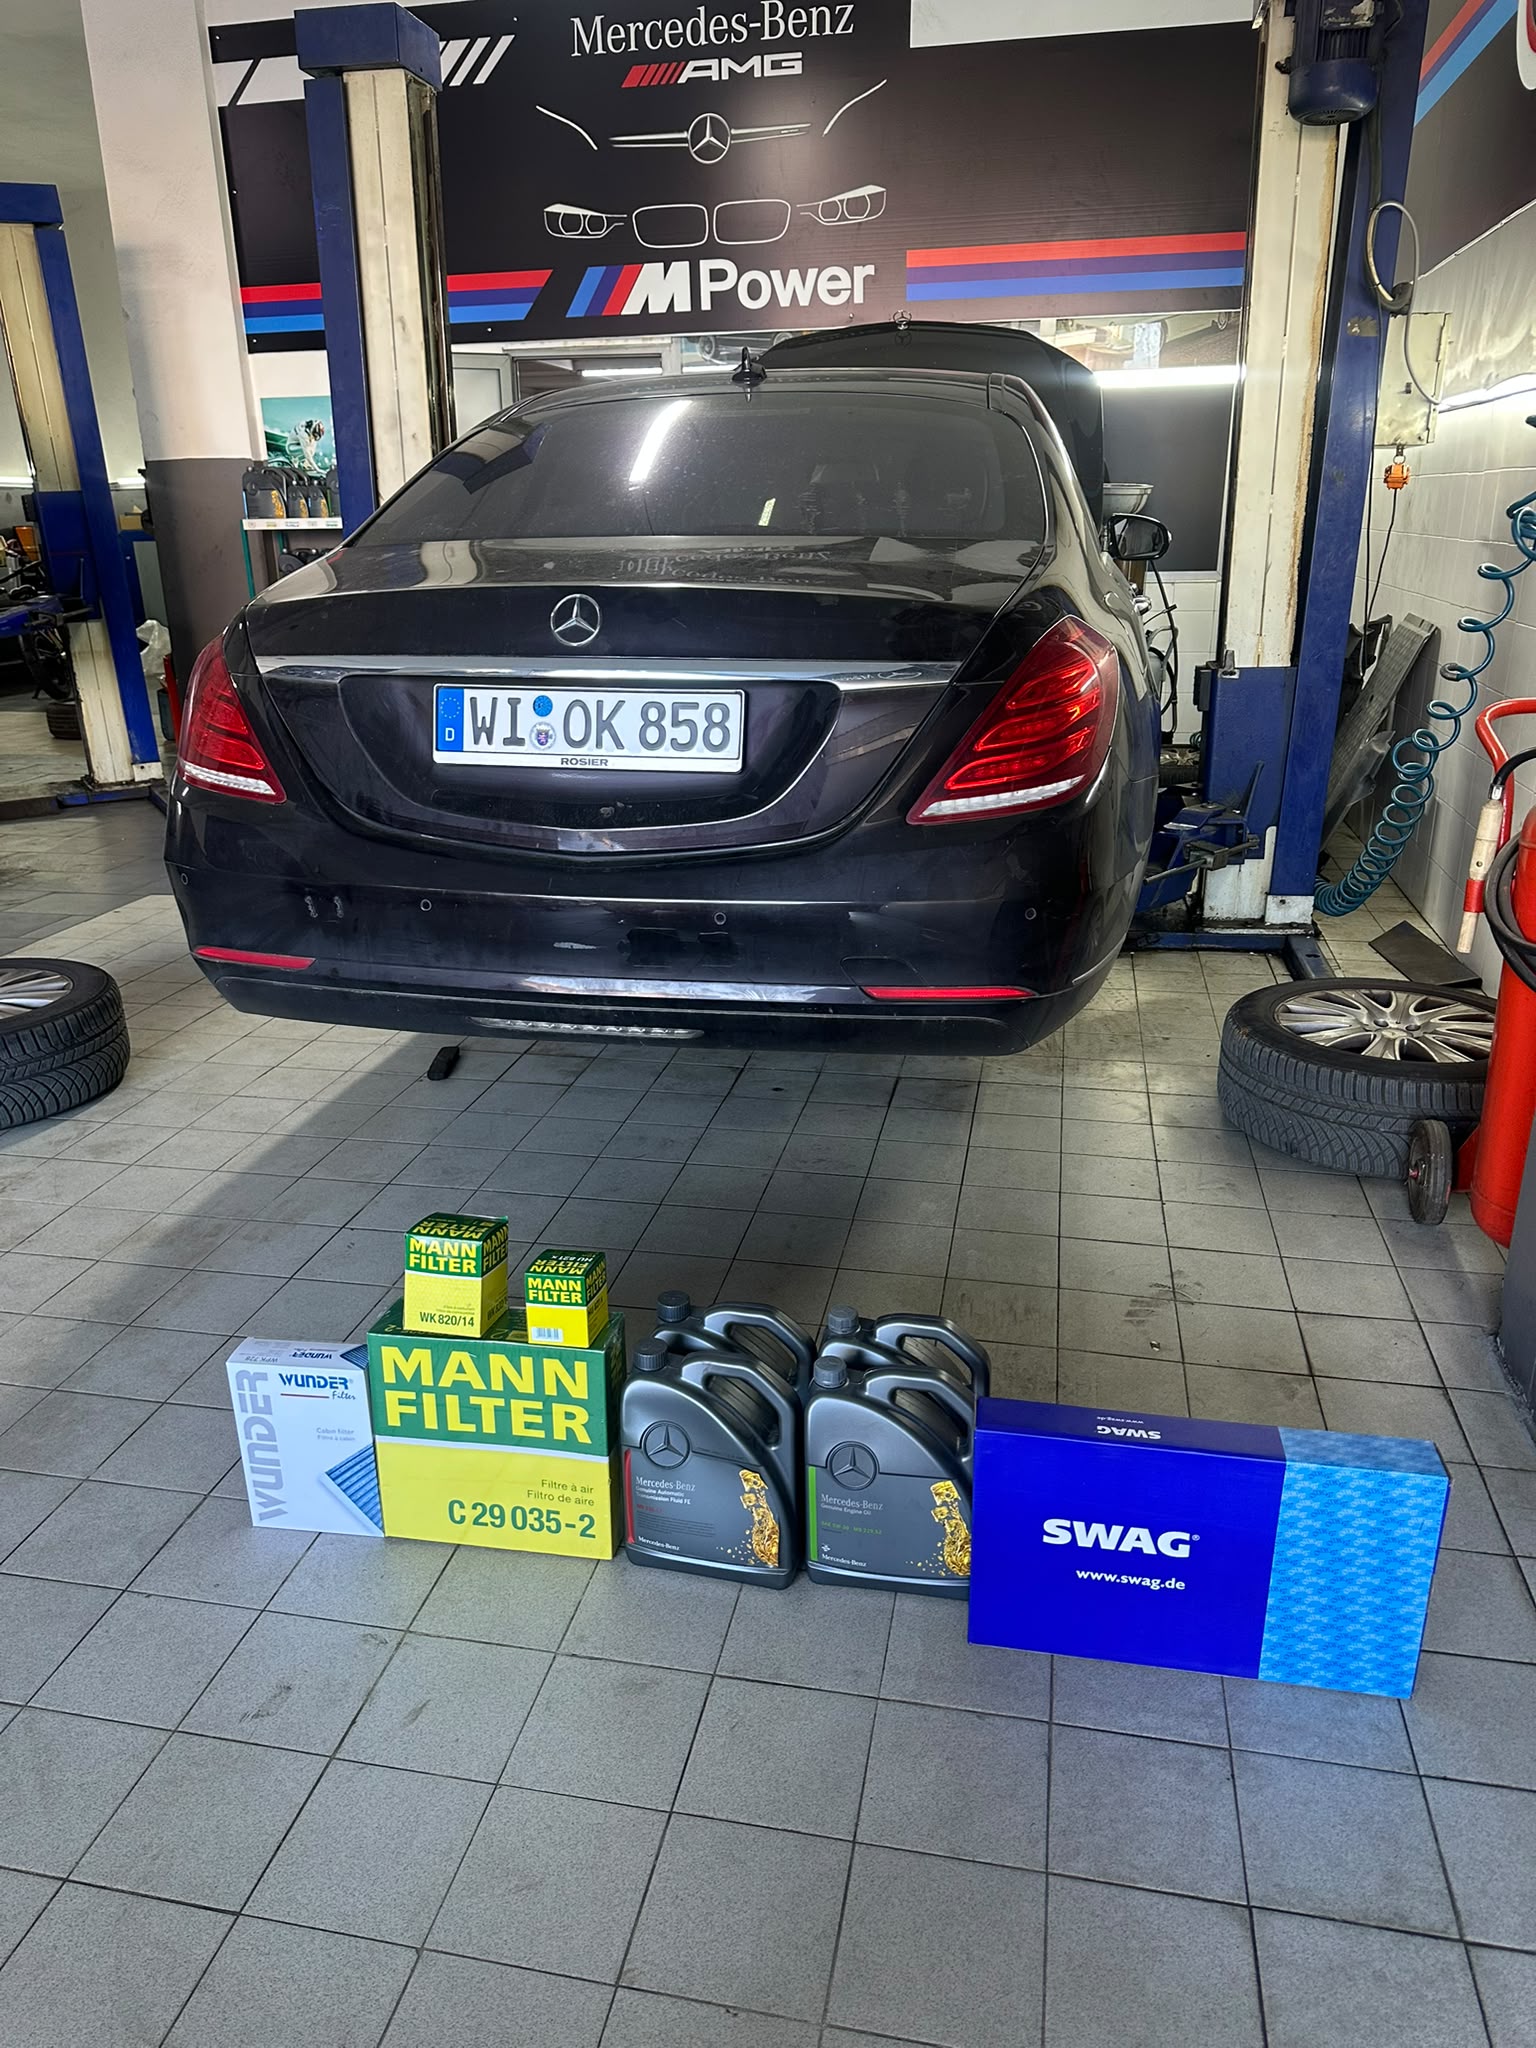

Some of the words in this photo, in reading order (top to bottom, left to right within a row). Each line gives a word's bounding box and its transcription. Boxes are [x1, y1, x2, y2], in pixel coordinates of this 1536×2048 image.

[571, 1, 855, 57] Mercedes-Benz
[678, 51, 803, 84] AMG
[701, 258, 876, 312] Power
[469, 696, 527, 748] WI
[563, 699, 627, 750] OK
[638, 701, 731, 753] 858
[445, 727, 455, 742] D
[560, 757, 609, 767] ROSIER
[412, 1226, 483, 1239] MANN
[409, 1237, 477, 1258] MANN
[409, 1252, 477, 1274] FILTER
[529, 1264, 585, 1275] MANN
[534, 1259, 589, 1268] FILTER
[527, 1277, 583, 1292] MANN
[528, 1289, 583, 1304] FILTER
[419, 1311, 436, 1324] WK
[438, 1312, 475, 1328] 820/14
[380, 1345, 589, 1400] MANN
[279, 1373, 349, 1390] WUNDER
[332, 1391, 356, 1401] Filter
[384, 1389, 593, 1445] FILTER
[1096, 1425, 1161, 1440] SWAG
[235, 1369, 289, 1521] WUNDER
[541, 1479, 568, 1491] Filtre
[580, 1485, 594, 1494] air
[636, 1476, 696, 1491] Mercedes-Benz
[527, 1489, 555, 1501] Filtro
[558, 1493, 571, 1504] de
[574, 1496, 595, 1507] aire
[821, 1493, 884, 1511] Mercedes-Benz
[448, 1499, 466, 1525] C
[471, 1502, 506, 1529] 29
[511, 1505, 597, 1539] 035-2
[843, 1507, 862, 1515] Engine
[638, 1535, 680, 1551] Mercedes-Benz
[822, 1553, 867, 1567] Mercedes-Benz
[1075, 1569, 1186, 1592] www.swag.de
